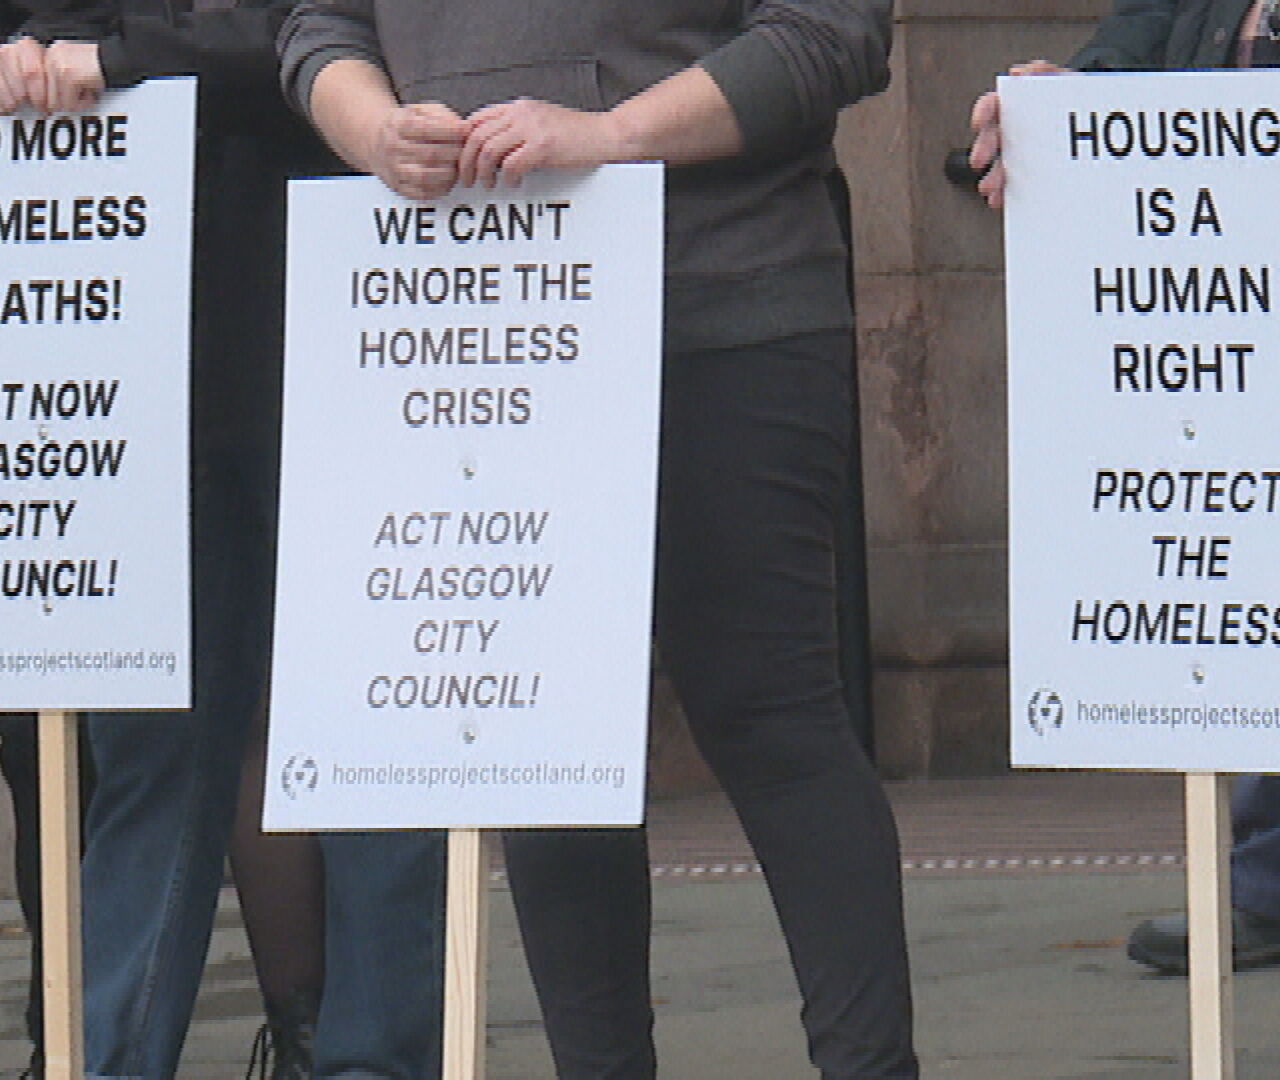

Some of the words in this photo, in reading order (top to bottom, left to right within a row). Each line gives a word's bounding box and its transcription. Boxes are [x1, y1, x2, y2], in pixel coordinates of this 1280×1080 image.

[13, 114, 128, 162] MORE
[1070, 108, 1280, 160] HOUSING
[374, 206, 437, 245] WE
[448, 202, 571, 242] CAN'T
[1136, 188, 1175, 236] IS
[1191, 188, 1222, 236] A
[352, 268, 500, 308] IGNORE
[513, 264, 592, 300] THE
[1094, 268, 1270, 315] HUMAN
[360, 324, 578, 368] HOMELESS
[1114, 344, 1254, 392] RIGHT
[30, 380, 118, 420] NOW
[404, 388, 530, 428] CRISIS
[374, 512, 450, 548] ACT
[458, 512, 549, 544] NOW
[1152, 536, 1230, 580] THE
[367, 564, 552, 600] GLASGOW
[414, 620, 499, 656] CITY
[368, 676, 540, 708] COUNCIL!
[333, 760, 624, 788] homelessprojectscotland.org
